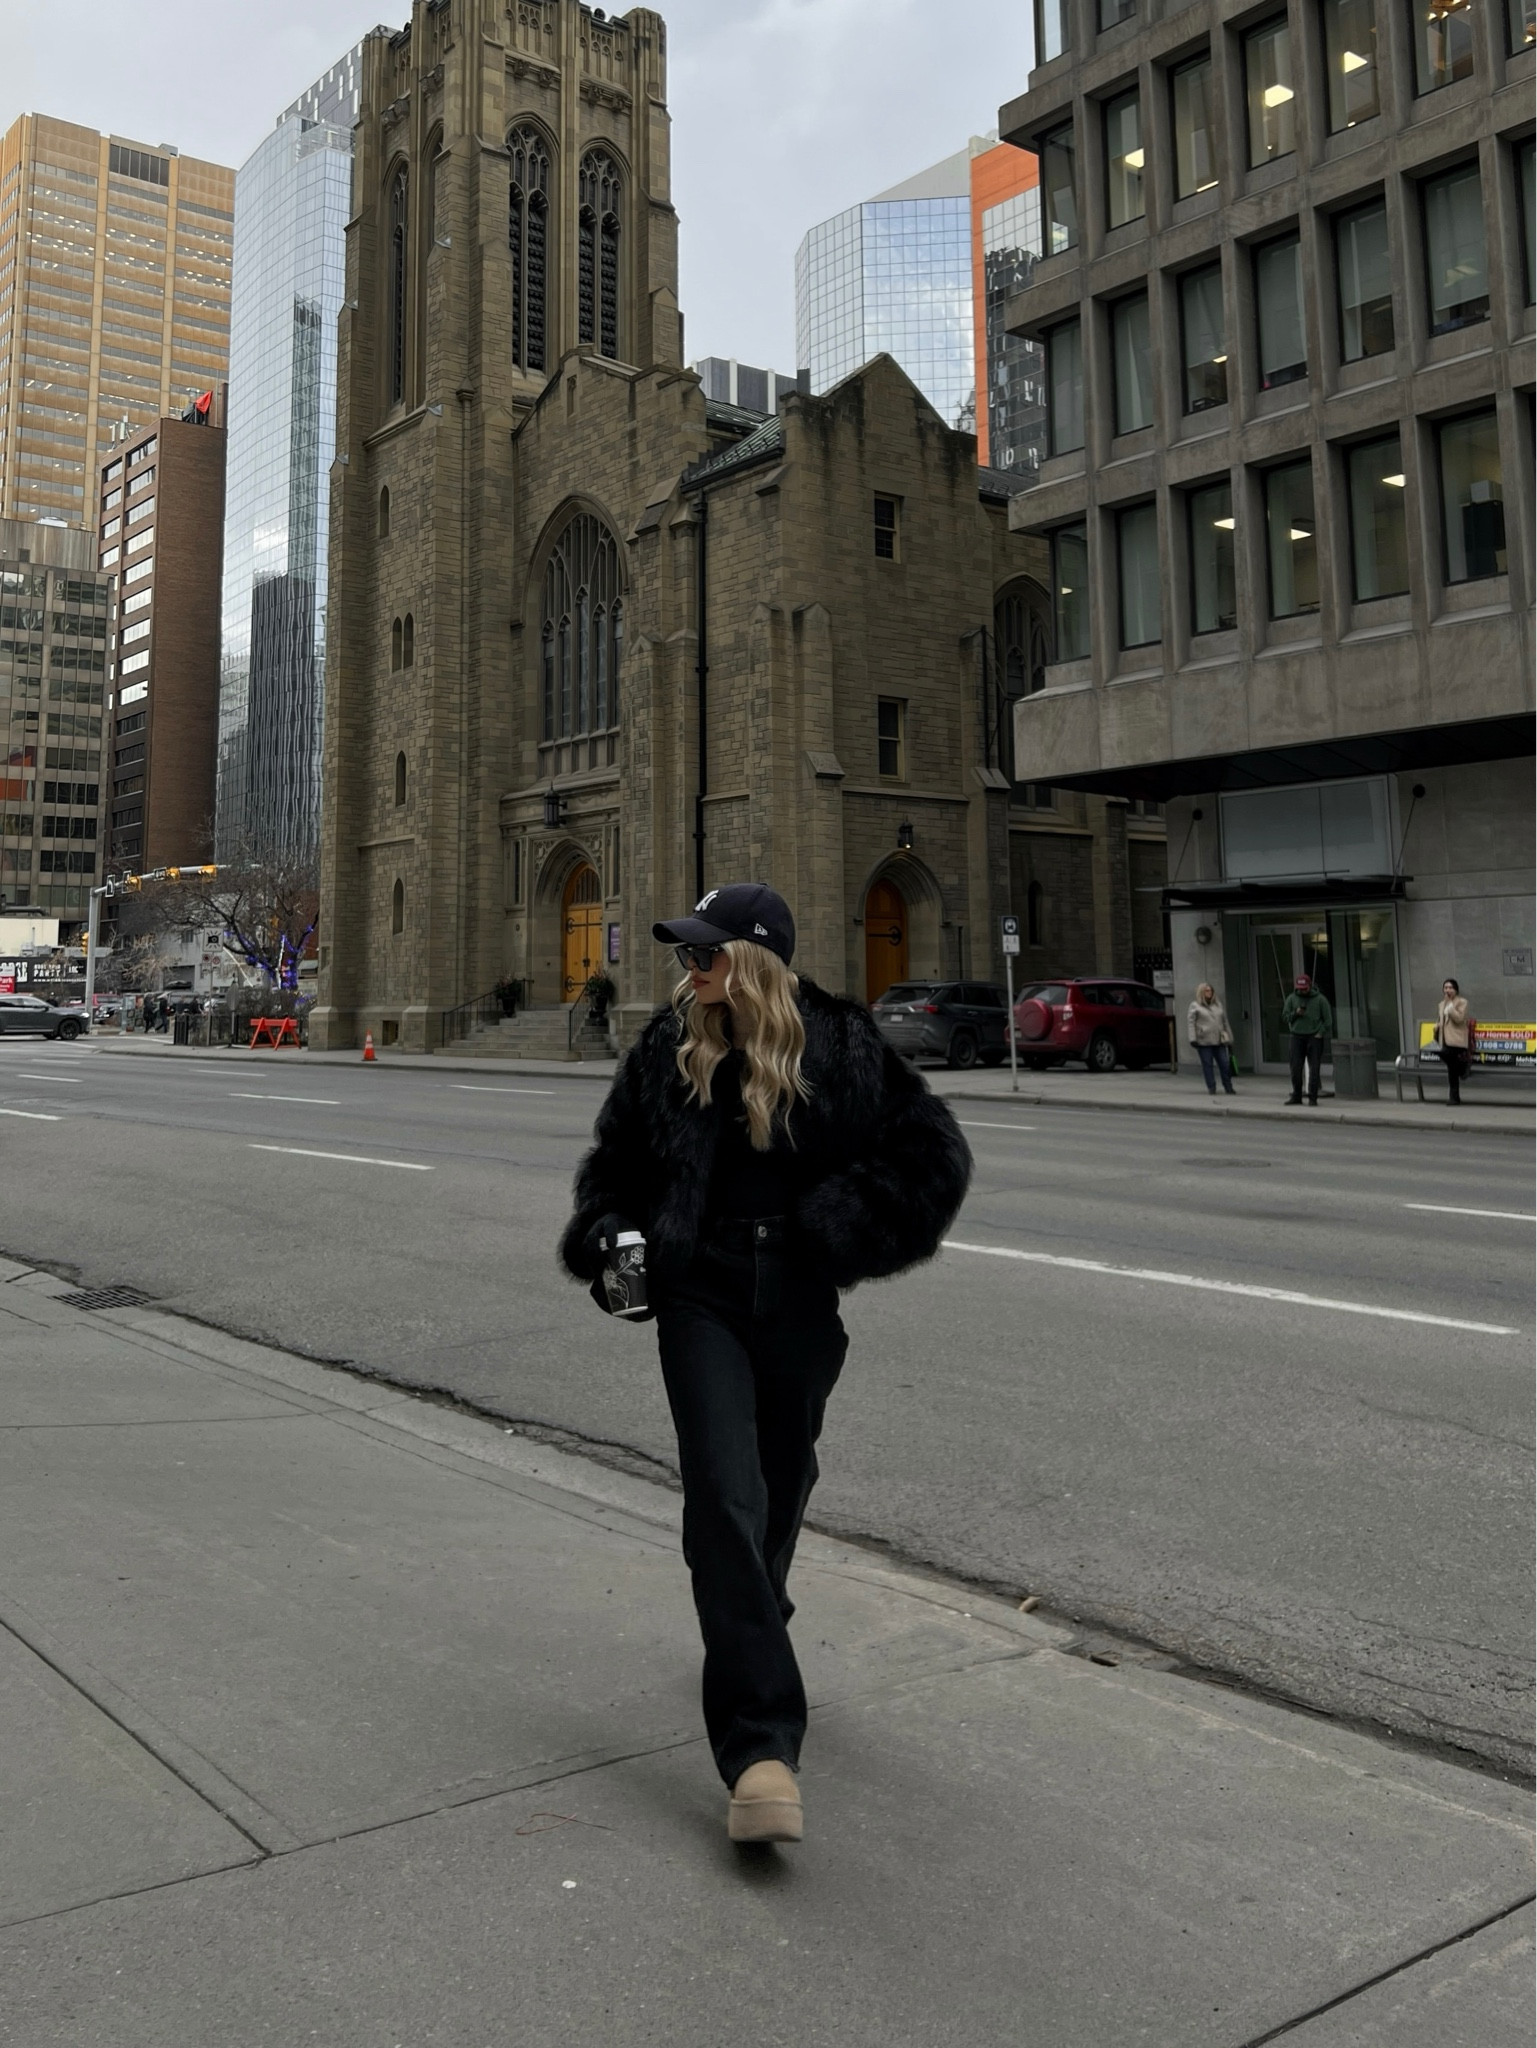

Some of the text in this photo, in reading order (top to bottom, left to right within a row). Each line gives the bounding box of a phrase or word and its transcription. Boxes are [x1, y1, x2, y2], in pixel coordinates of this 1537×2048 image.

[33, 969, 61, 977] PARTY
[1486, 1031, 1509, 1039] Home
[1510, 1030, 1534, 1039] SOLD!
